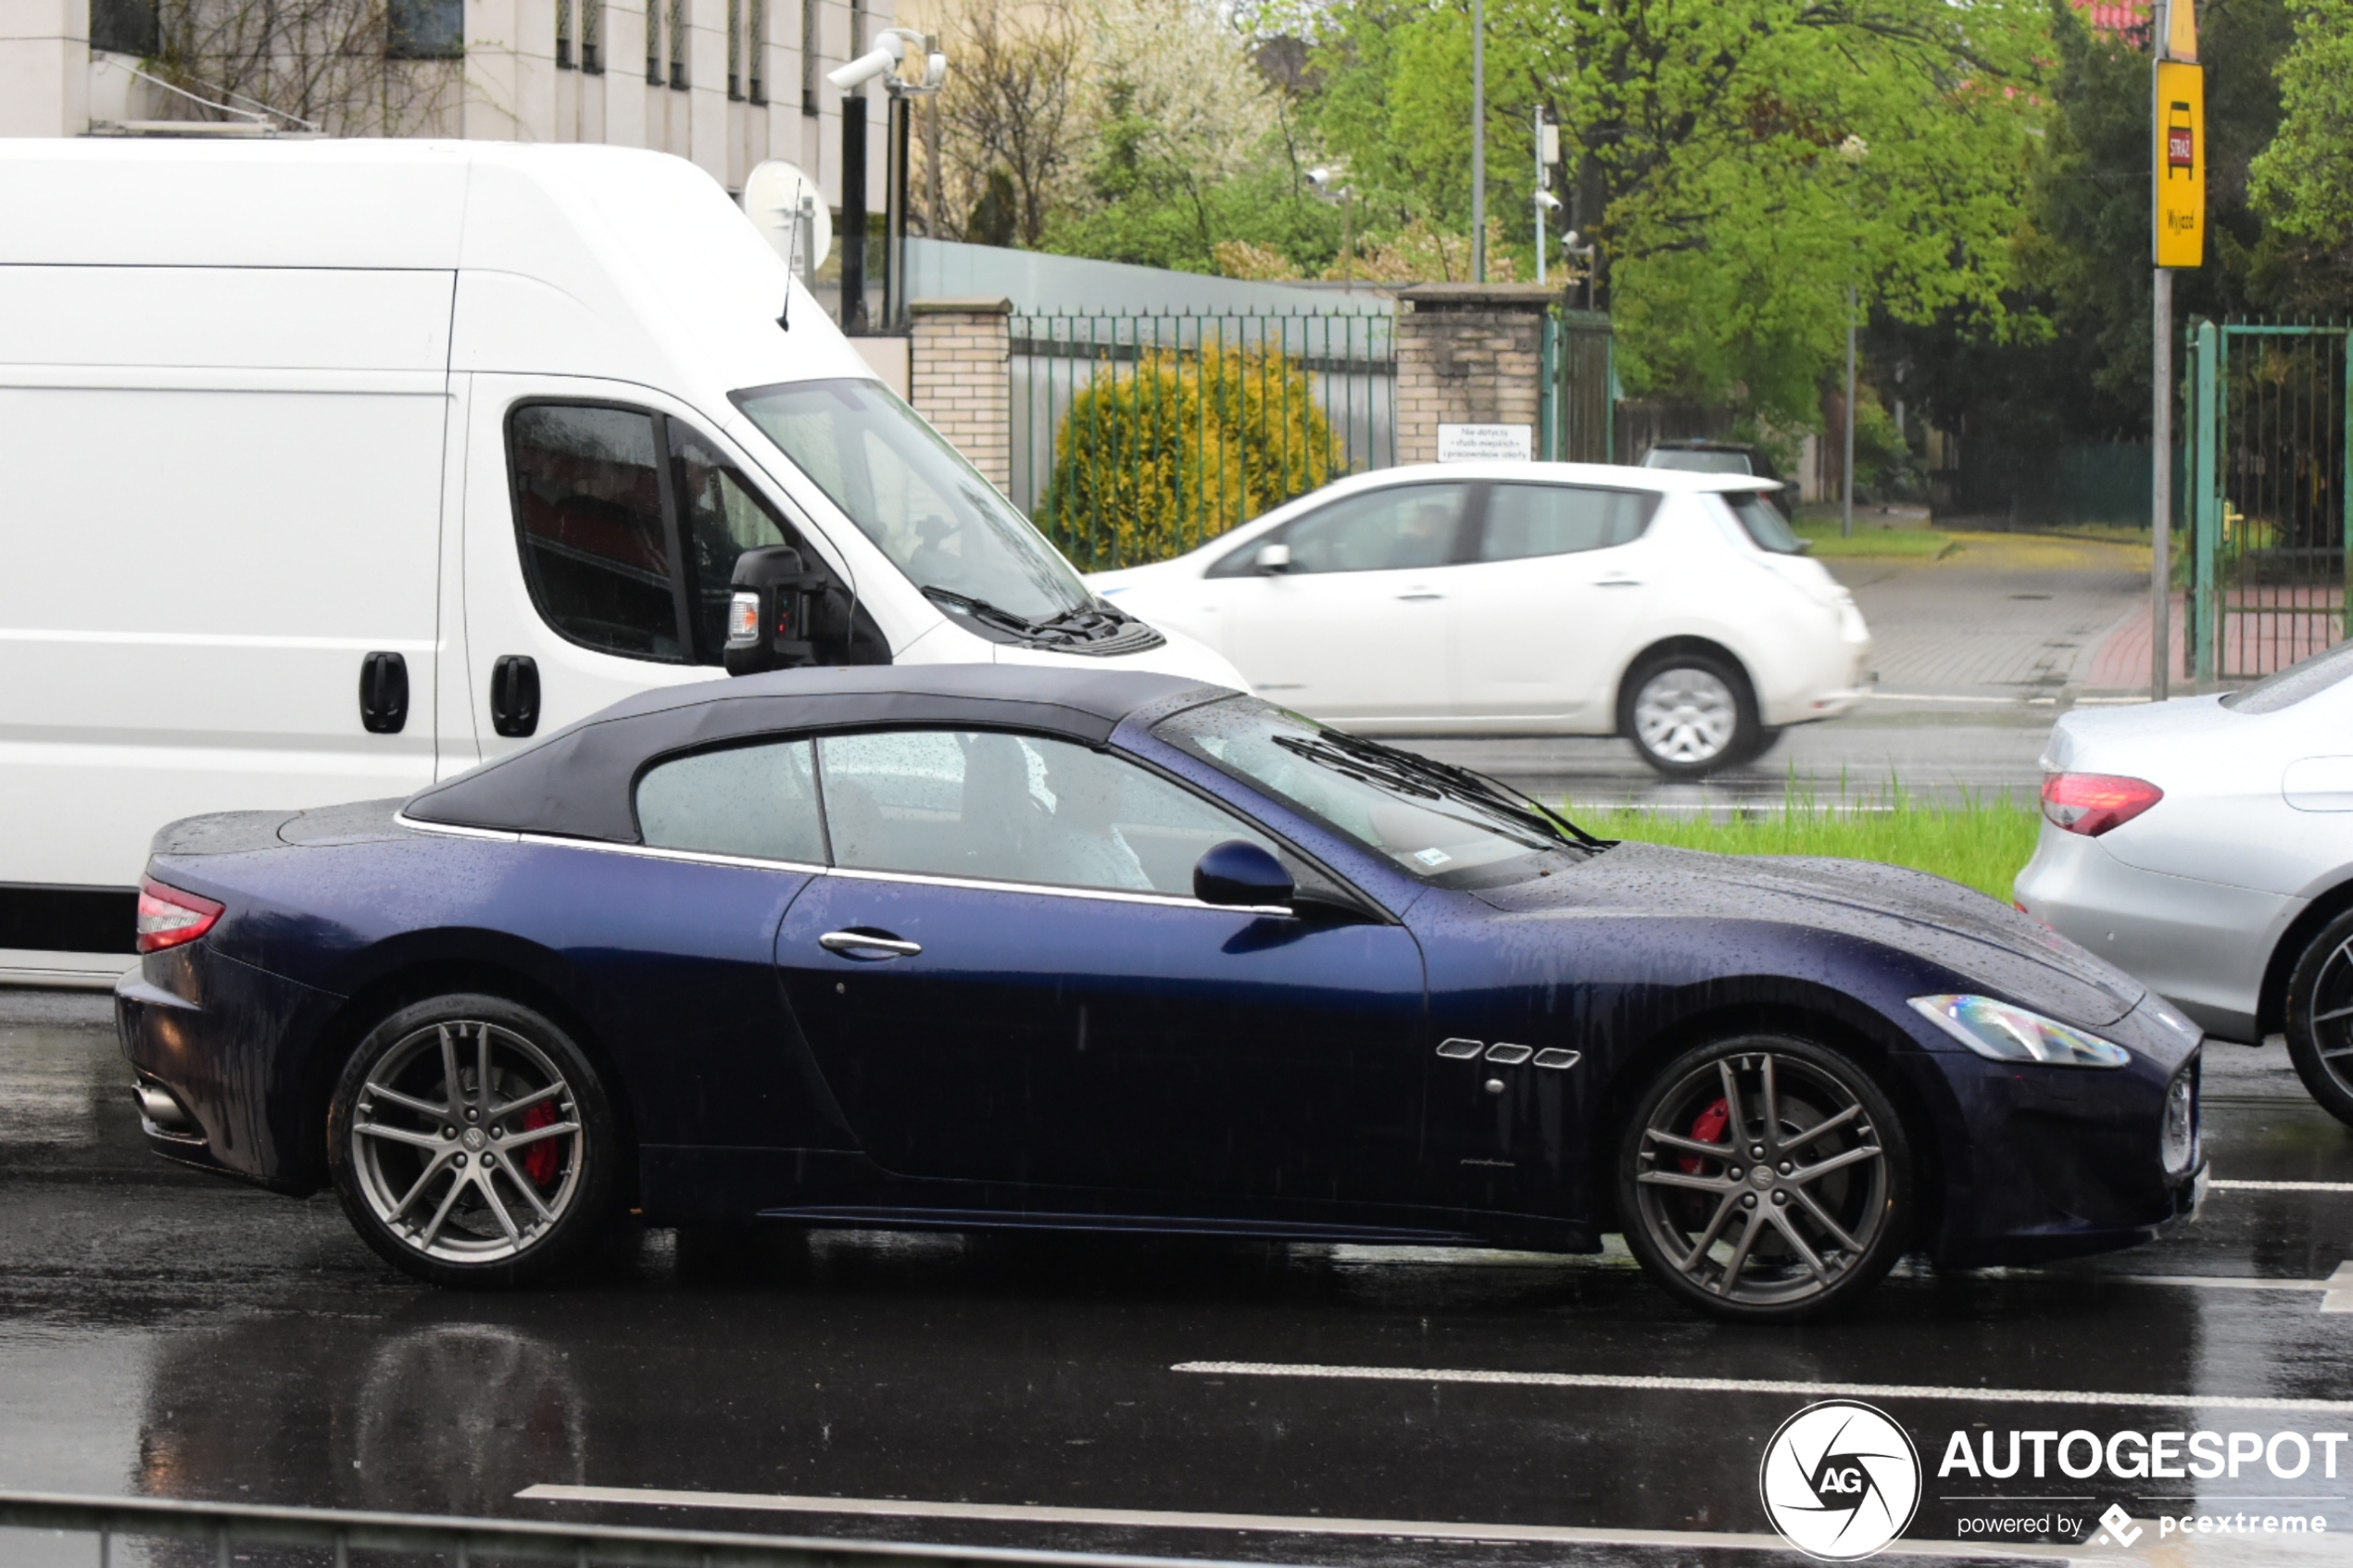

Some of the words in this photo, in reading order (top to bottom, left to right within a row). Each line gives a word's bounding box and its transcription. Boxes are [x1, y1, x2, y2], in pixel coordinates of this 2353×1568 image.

[2170, 135, 2191, 158] STRAŻ
[2167, 208, 2195, 235] Wyjazd
[1477, 428, 1508, 437] dotyczy
